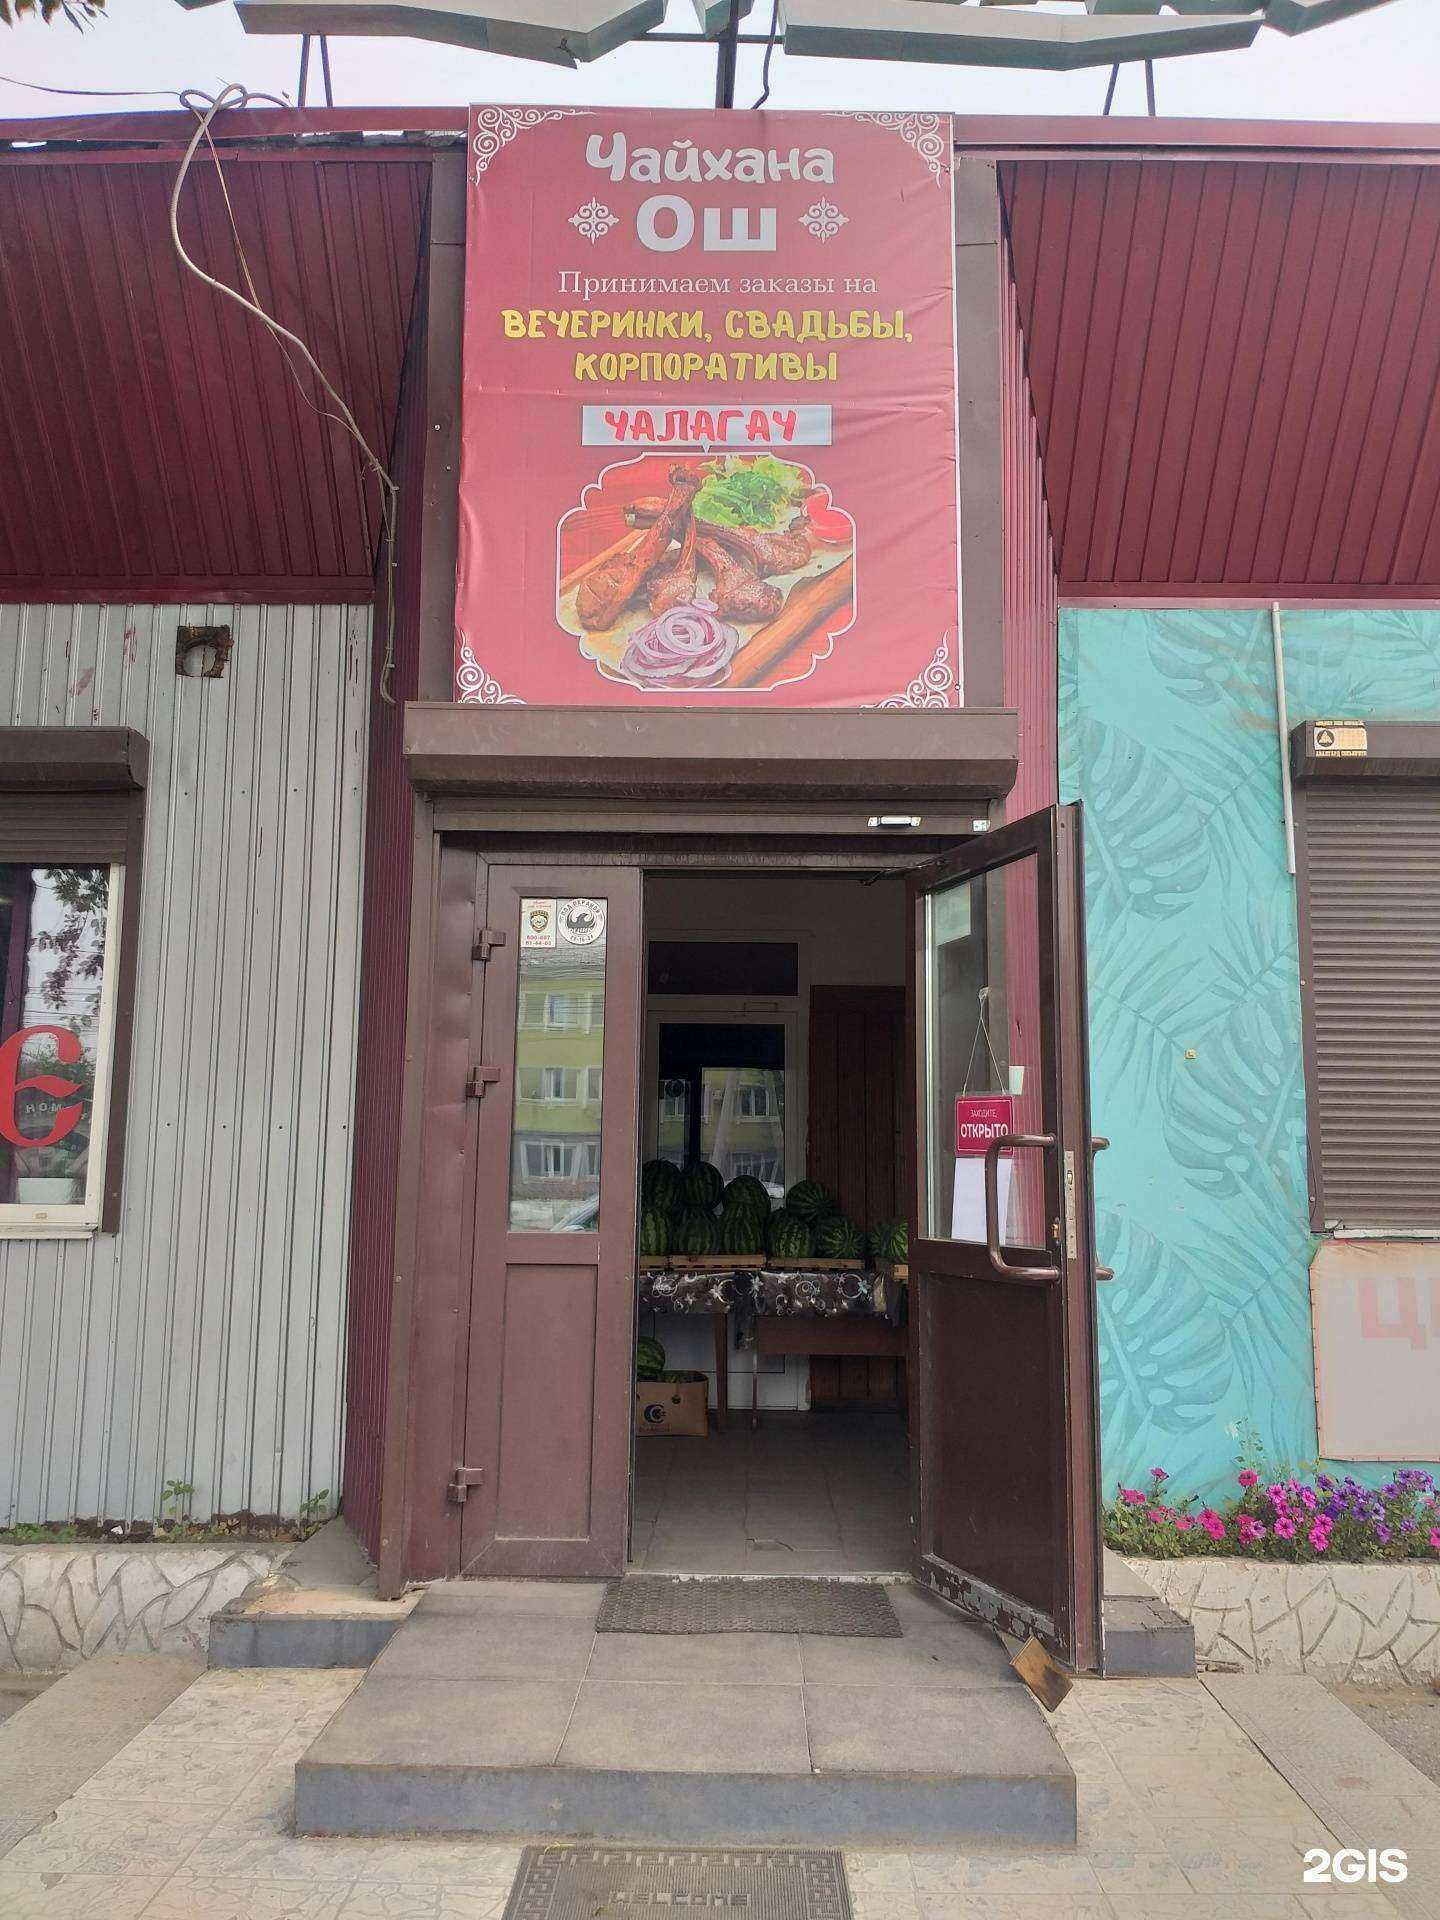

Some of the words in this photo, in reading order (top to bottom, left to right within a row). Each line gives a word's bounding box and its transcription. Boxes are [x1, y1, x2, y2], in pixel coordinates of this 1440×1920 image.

[585, 132, 835, 184] Чайхана
[558, 271, 731, 301] Принимаем
[739, 277, 835, 294] заказы
[843, 277, 878, 294] на
[501, 309, 713, 343] ВЕЧЕРИНКИ,
[725, 310, 913, 343] СВАДЬБЫ,
[574, 352, 838, 381] КОРПОРАТИВЫ
[604, 409, 799, 442] ЧАЛАГАЧ
[960, 1123, 1009, 1138] ОТКРЫТО
